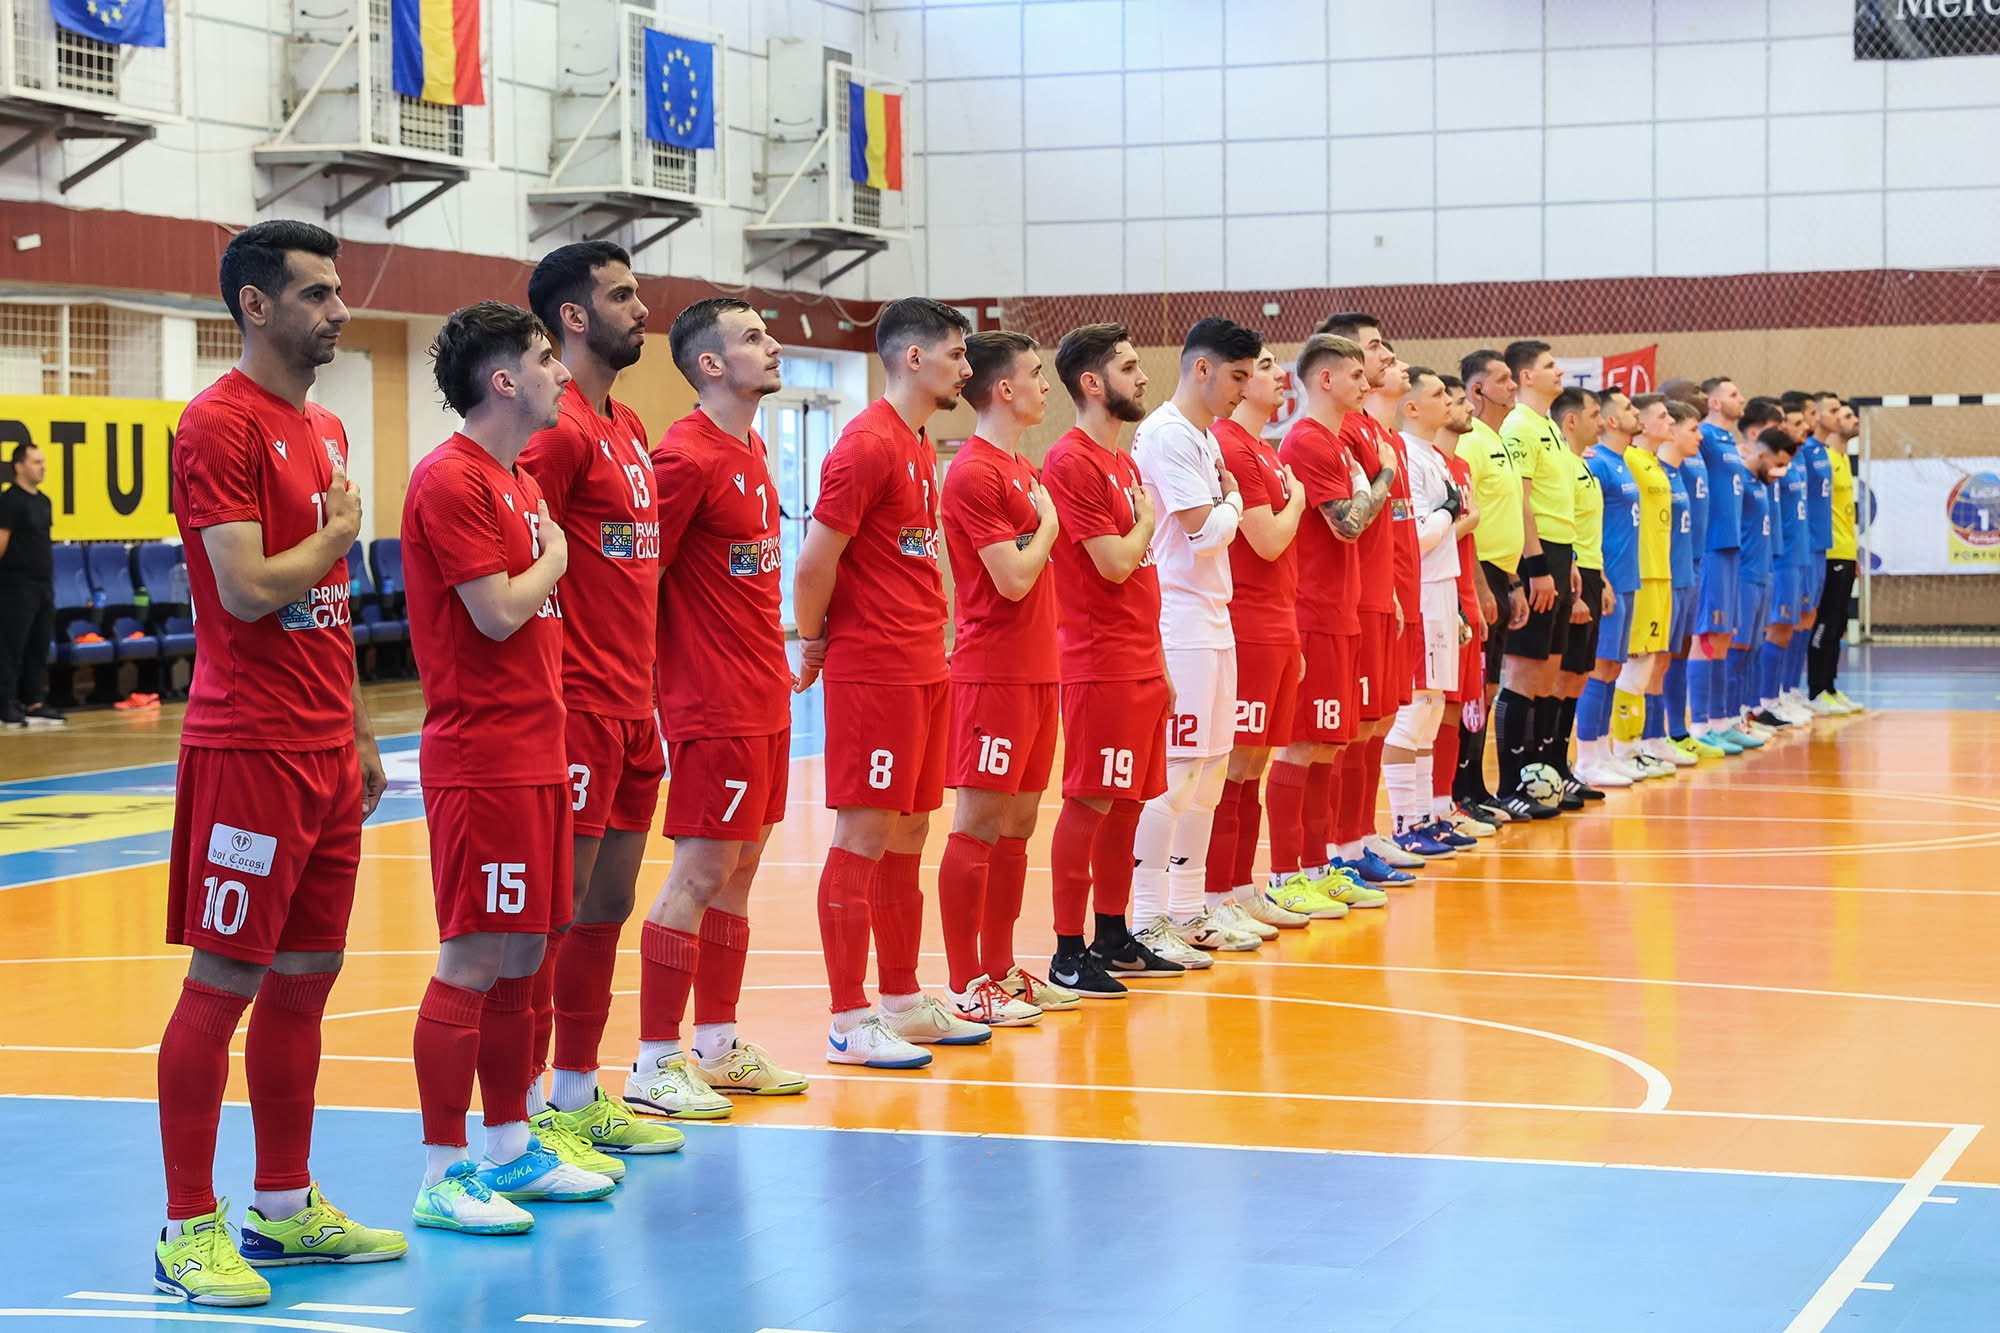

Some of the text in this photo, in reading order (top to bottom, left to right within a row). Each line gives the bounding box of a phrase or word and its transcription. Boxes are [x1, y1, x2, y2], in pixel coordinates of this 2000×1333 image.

[0, 420, 174, 515] RTU
[623, 464, 650, 508] 13
[1977, 508, 1990, 531] 1
[1650, 621, 1659, 637] 2
[1168, 714, 1198, 747] 12
[1235, 700, 1266, 733] 20
[1313, 699, 1341, 729] 18
[869, 749, 894, 790] 8
[978, 735, 1012, 776] 16
[1100, 747, 1133, 789] 19
[721, 779, 748, 822] 7
[202, 876, 249, 935] 10
[481, 862, 526, 914] 15
